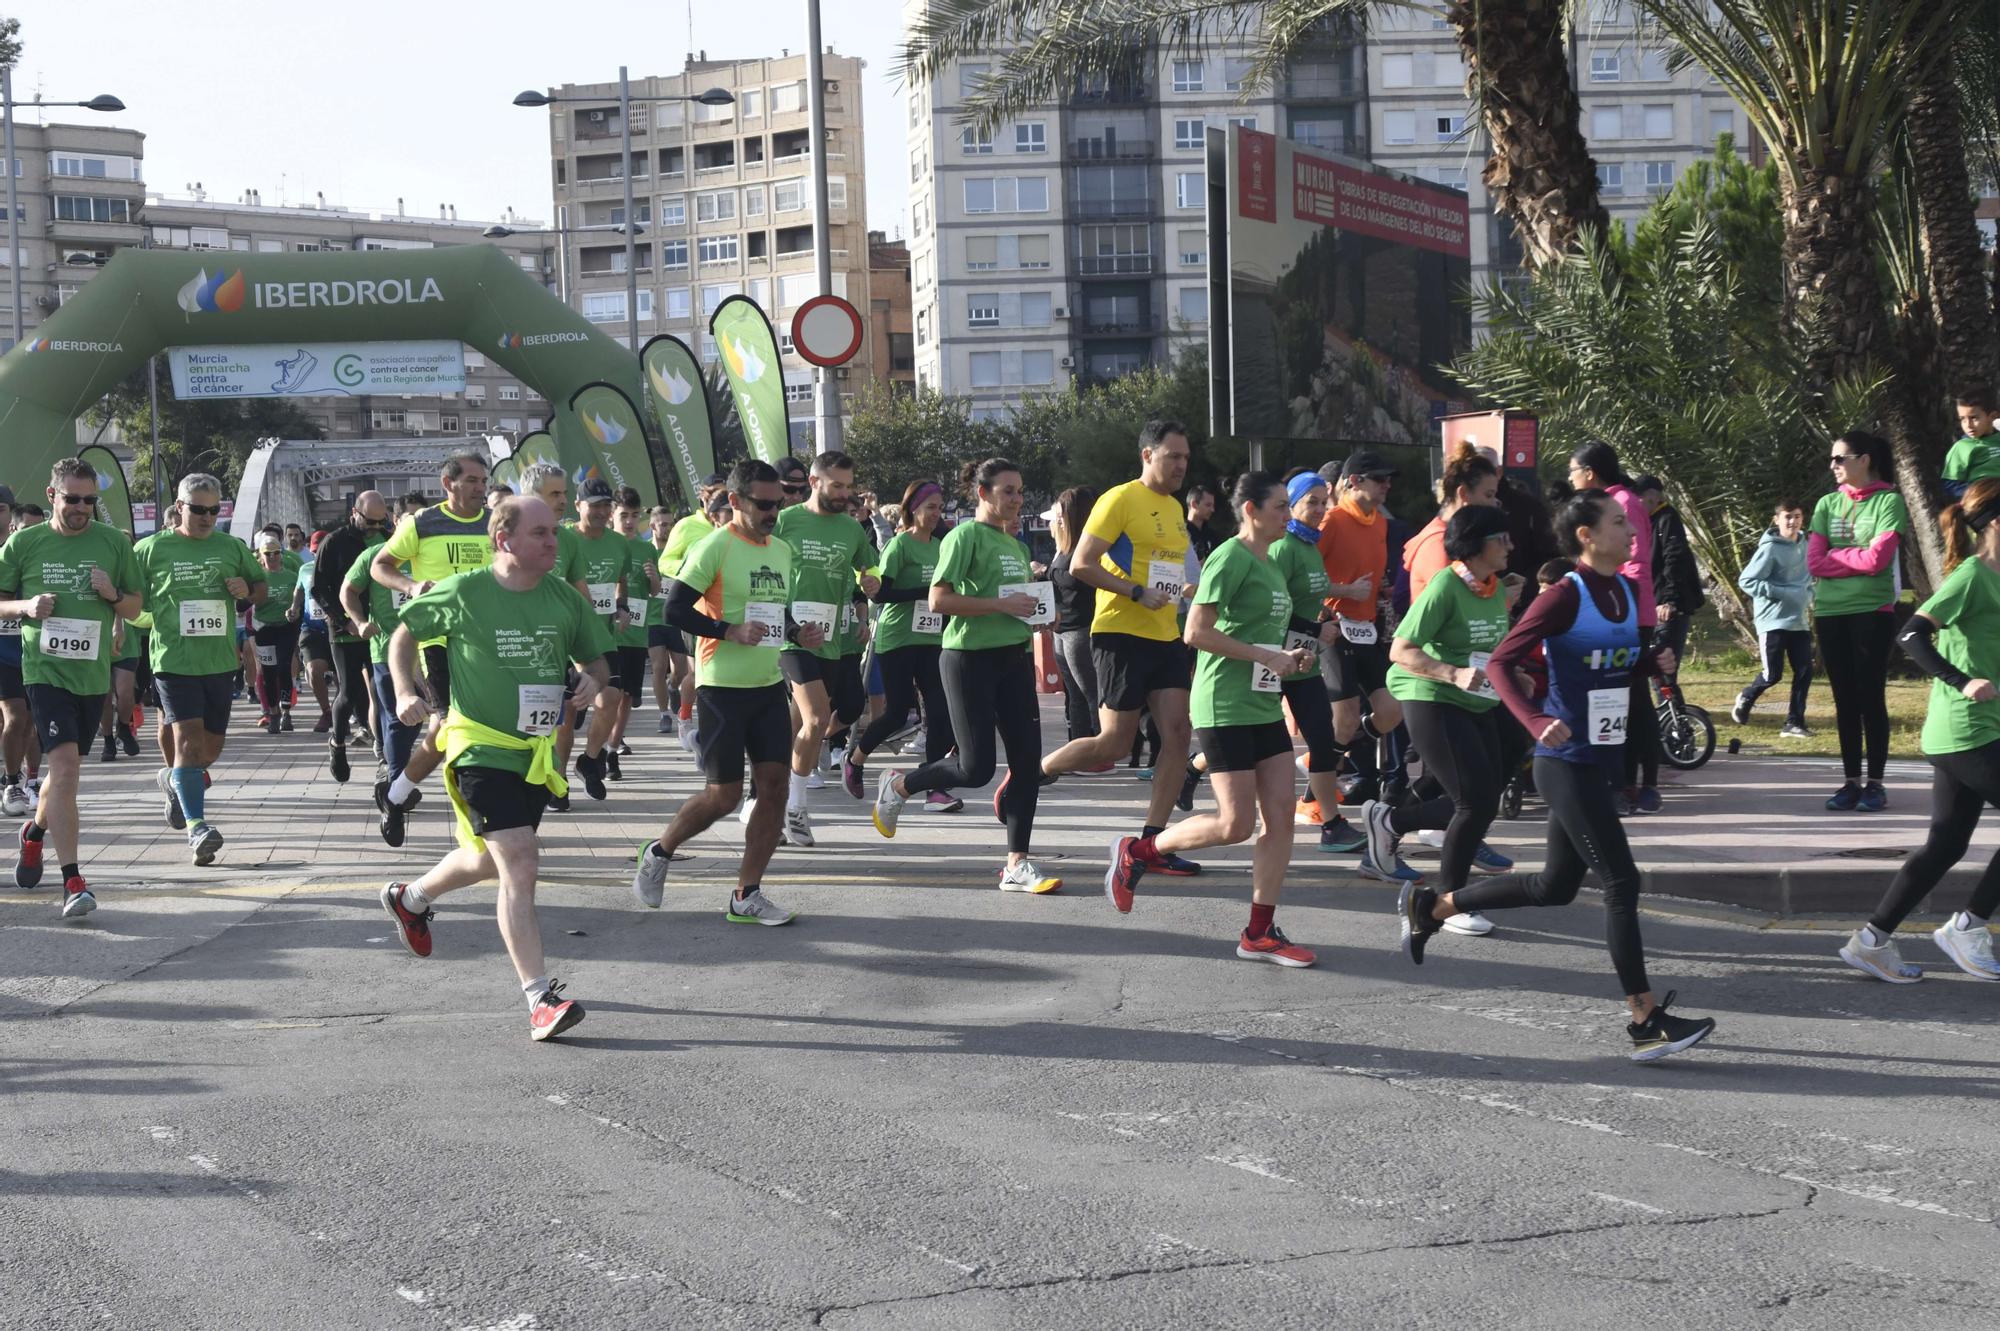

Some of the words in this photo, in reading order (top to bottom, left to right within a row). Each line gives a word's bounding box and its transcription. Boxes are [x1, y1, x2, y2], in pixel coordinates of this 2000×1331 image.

[1297, 162, 1334, 193] MURCIA
[1297, 188, 1314, 213] RIO
[1367, 187, 1377, 203] DE
[1431, 205, 1438, 219] Y
[1439, 207, 1464, 226] MEJORA
[1340, 201, 1350, 216] DE
[1352, 204, 1366, 220] LOS
[1409, 219, 1422, 235] DEL
[255, 278, 444, 308] IBERDROLA
[522, 332, 589, 346] IBERDROLA
[50, 340, 122, 352] IBERDROLA
[188, 354, 228, 364] Murcia
[370, 355, 416, 364] asociación
[418, 354, 456, 365] española
[190, 366, 204, 374] en
[205, 363, 250, 373] marcha
[370, 366, 398, 374] contra
[400, 365, 408, 373] el
[190, 374, 227, 383] contra
[424, 374, 436, 382] de
[438, 373, 465, 382] Murcia
[191, 384, 202, 393] el
[204, 382, 244, 393] cáncer
[188, 618, 222, 628] 1196
[49, 637, 90, 650] 0190
